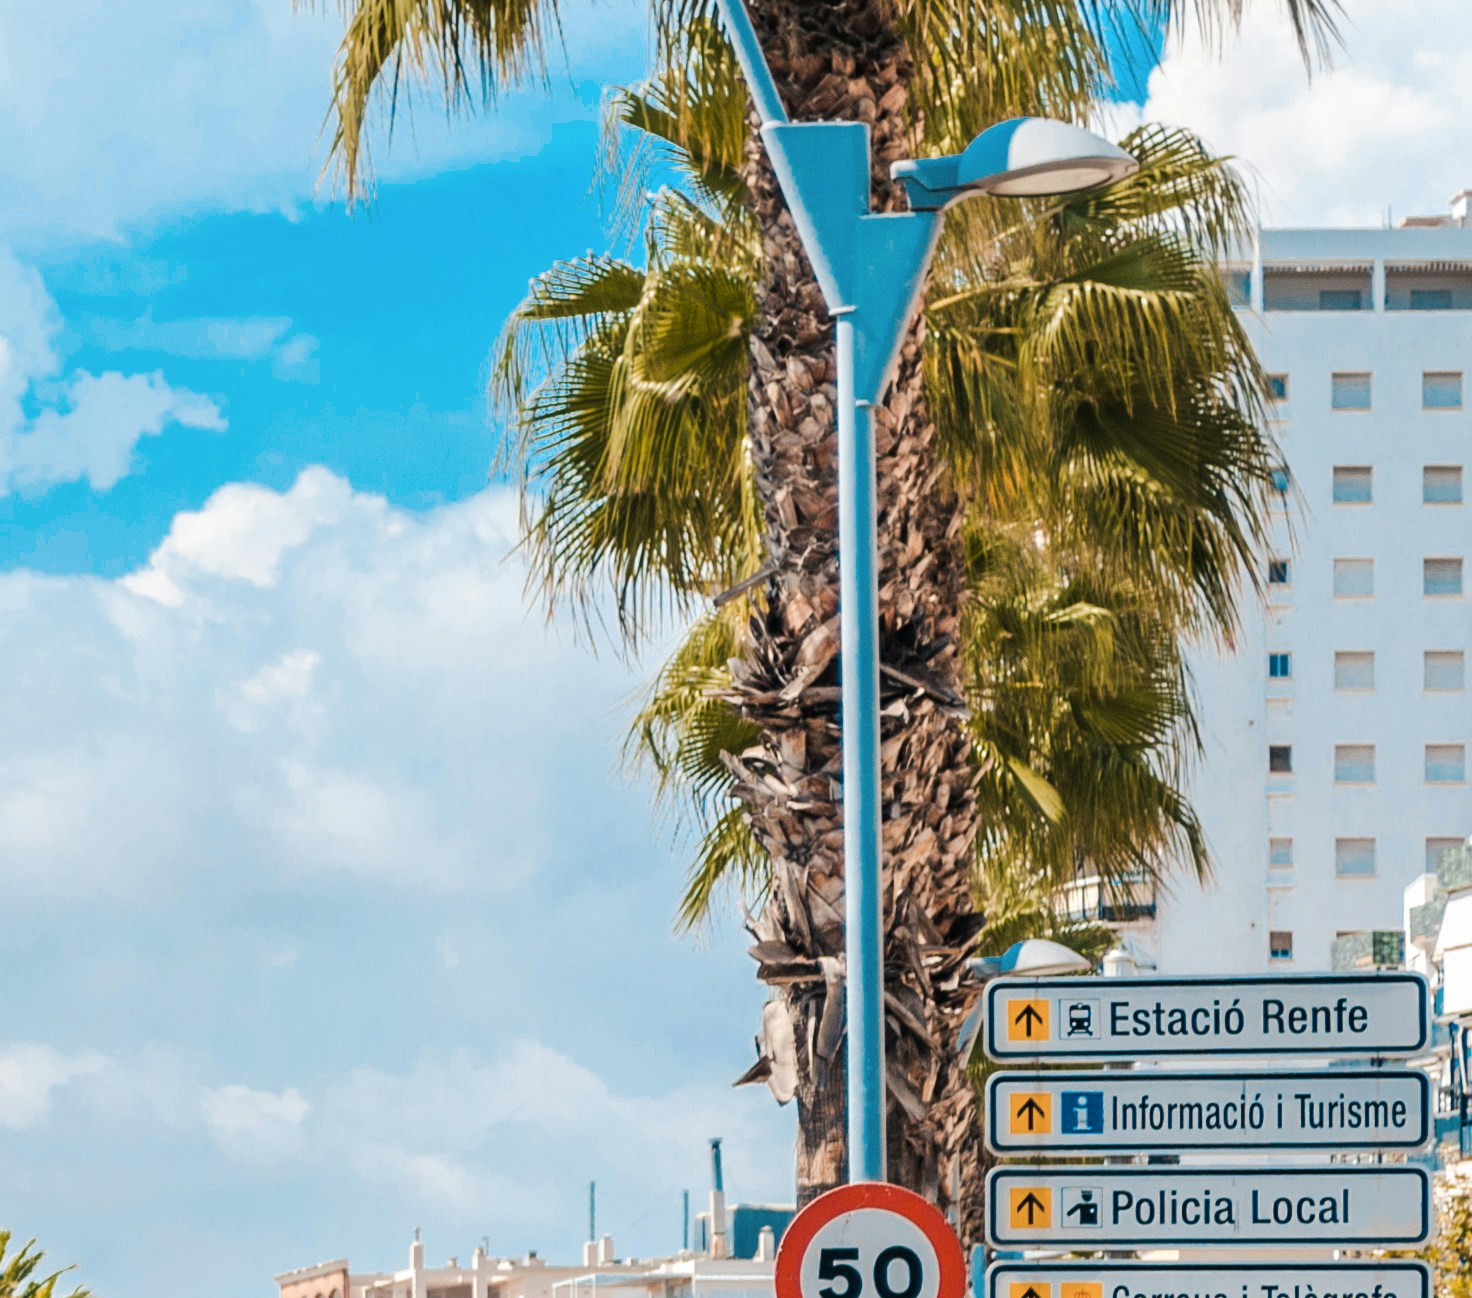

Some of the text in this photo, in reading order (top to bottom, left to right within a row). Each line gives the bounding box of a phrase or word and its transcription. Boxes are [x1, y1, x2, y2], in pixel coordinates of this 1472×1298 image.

[1109, 998, 1369, 1036] Estació Renfe
[1111, 1093, 1407, 1130] Informació i Turisme
[1111, 1188, 1350, 1226] Policia Local
